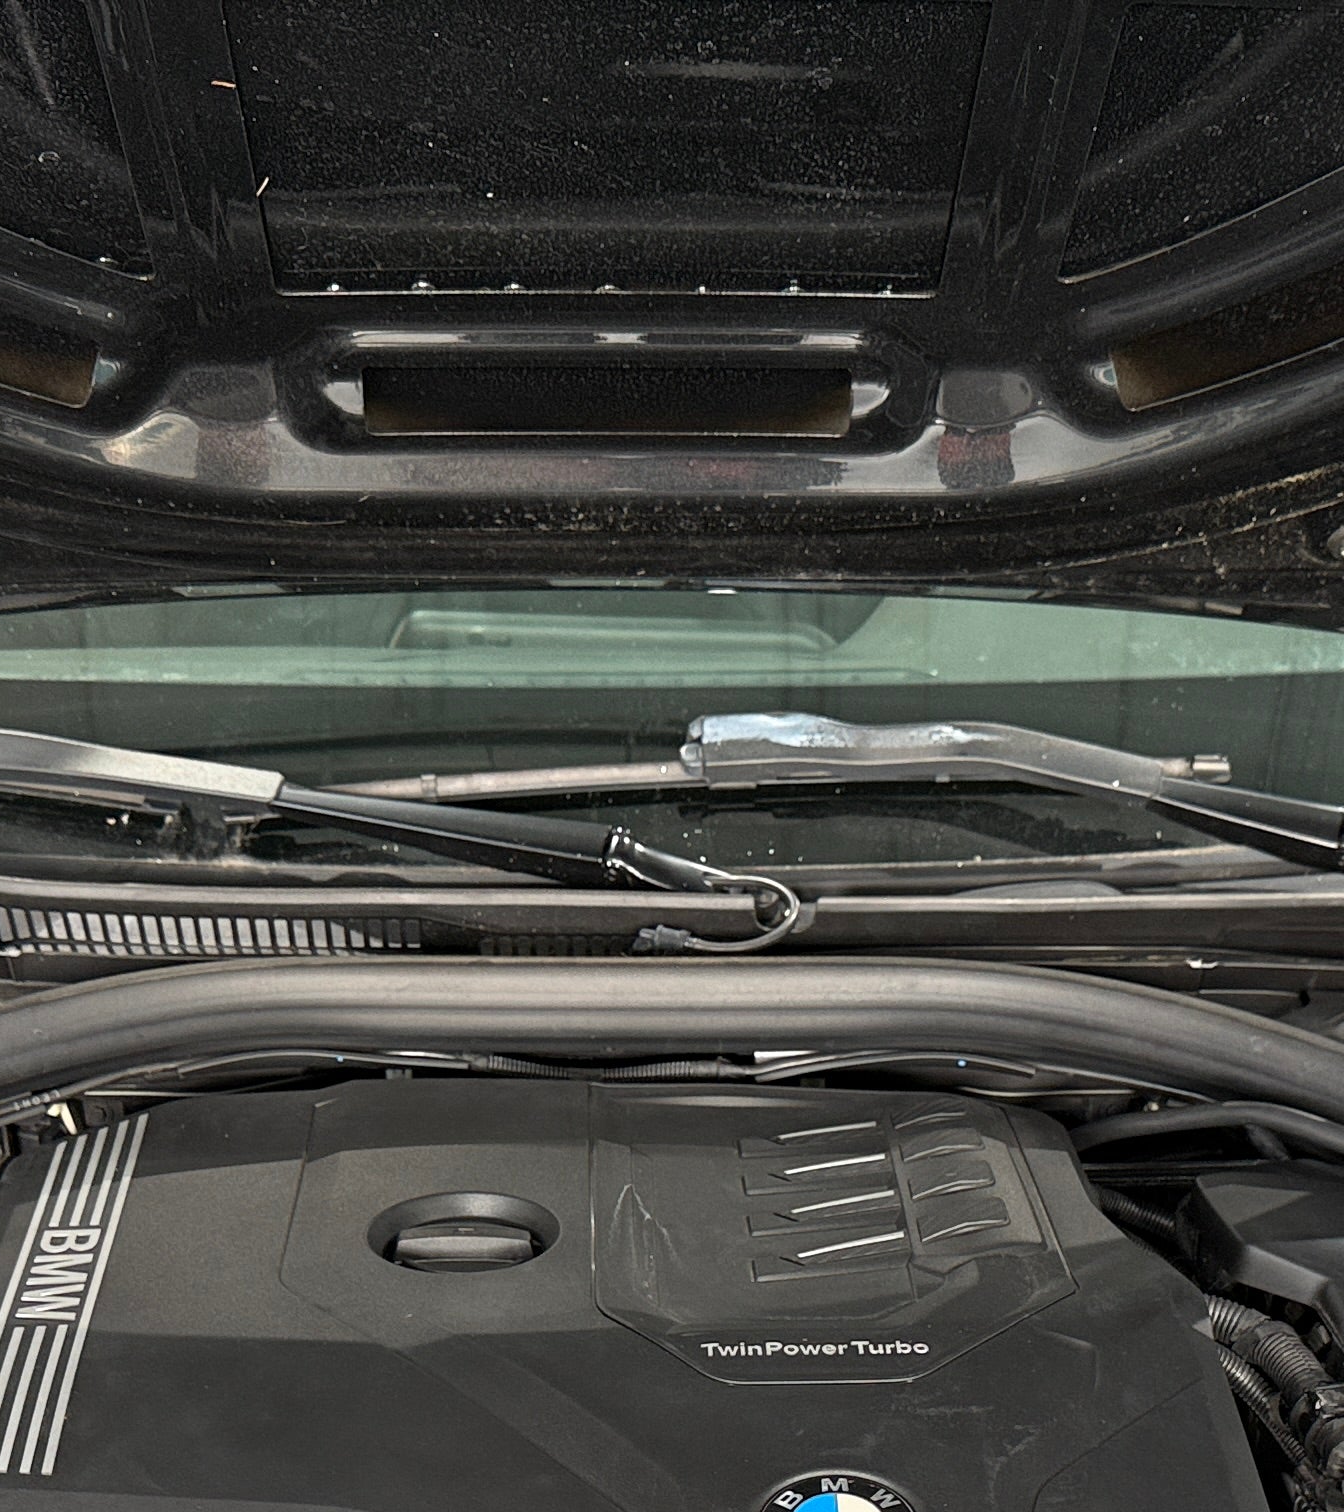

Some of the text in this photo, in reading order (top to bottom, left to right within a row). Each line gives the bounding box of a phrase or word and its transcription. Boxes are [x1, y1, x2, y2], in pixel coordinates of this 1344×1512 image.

[15, 1228, 102, 1321] BMW
[851, 1340, 930, 1356] Turbo
[773, 1477, 902, 1511] BMW
